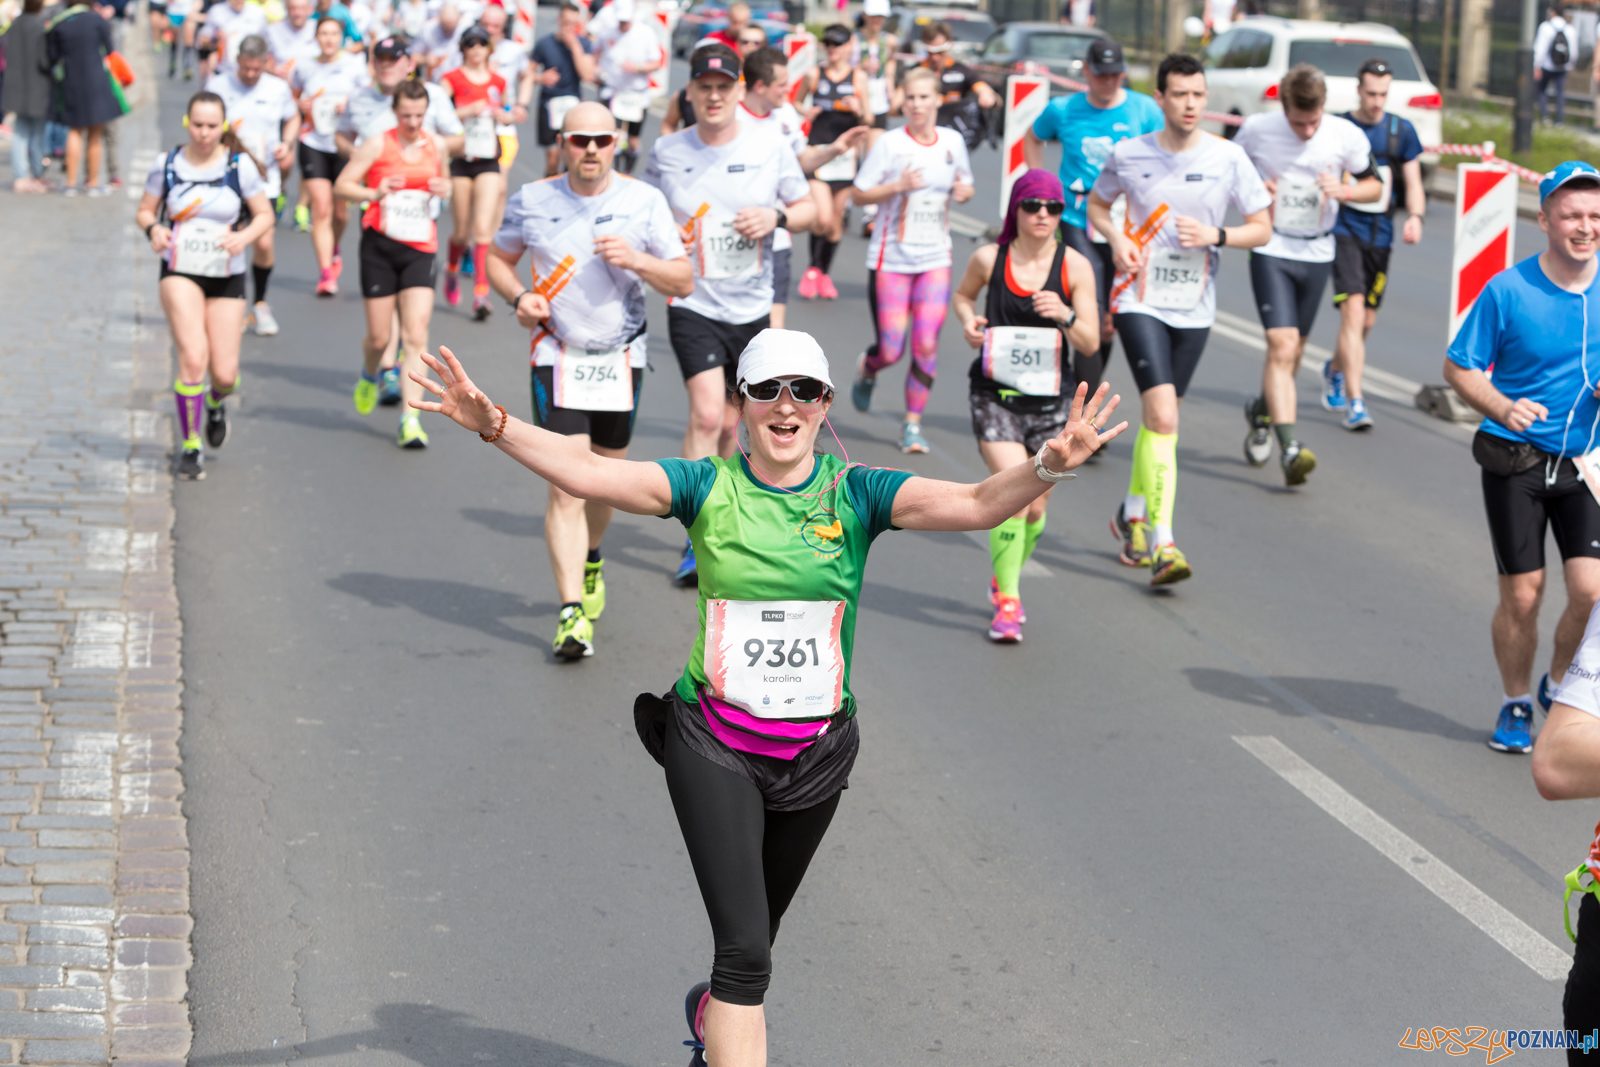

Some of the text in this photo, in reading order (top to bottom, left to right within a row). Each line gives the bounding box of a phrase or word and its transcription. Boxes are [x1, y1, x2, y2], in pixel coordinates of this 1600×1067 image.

[709, 236, 757, 251] 11960
[1154, 266, 1199, 284] 11534
[1010, 349, 1041, 366] 561
[574, 365, 617, 382] 5754
[743, 638, 819, 667] 9361
[763, 674, 802, 683] karolina
